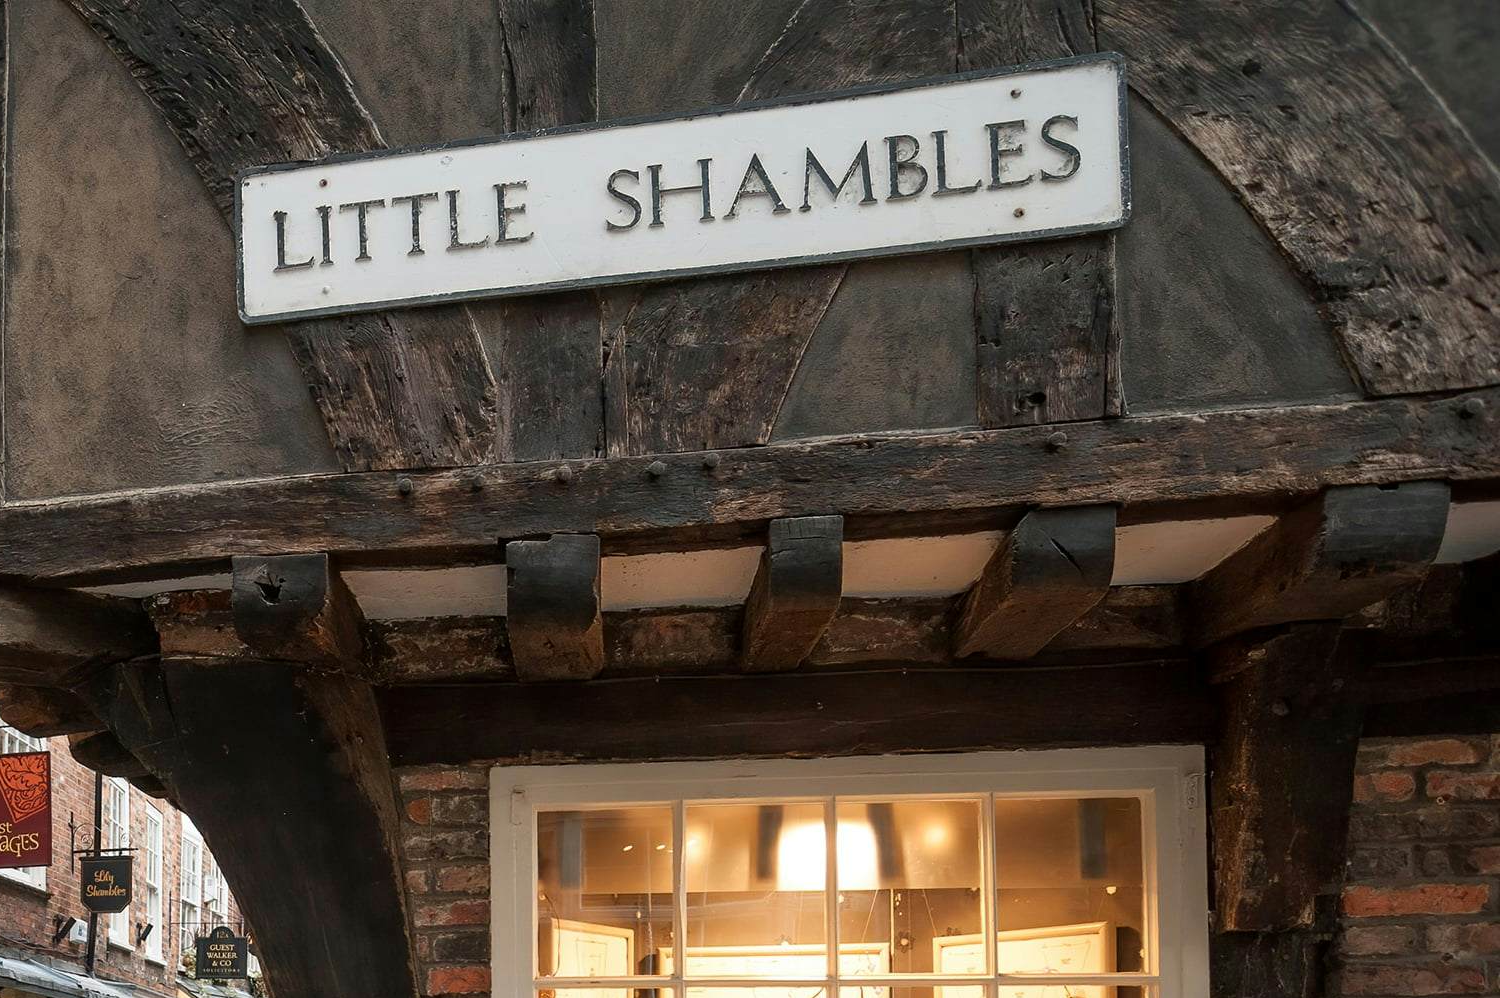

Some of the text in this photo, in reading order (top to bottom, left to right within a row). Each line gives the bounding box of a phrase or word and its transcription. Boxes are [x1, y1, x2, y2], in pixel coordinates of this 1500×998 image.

[272, 113, 1081, 274] LITTLE SHAMBLES
[94, 869, 114, 885] Lily
[85, 884, 127, 897] Shambles
[209, 943, 235, 951] GUEST
[206, 951, 238, 959] WALKER
